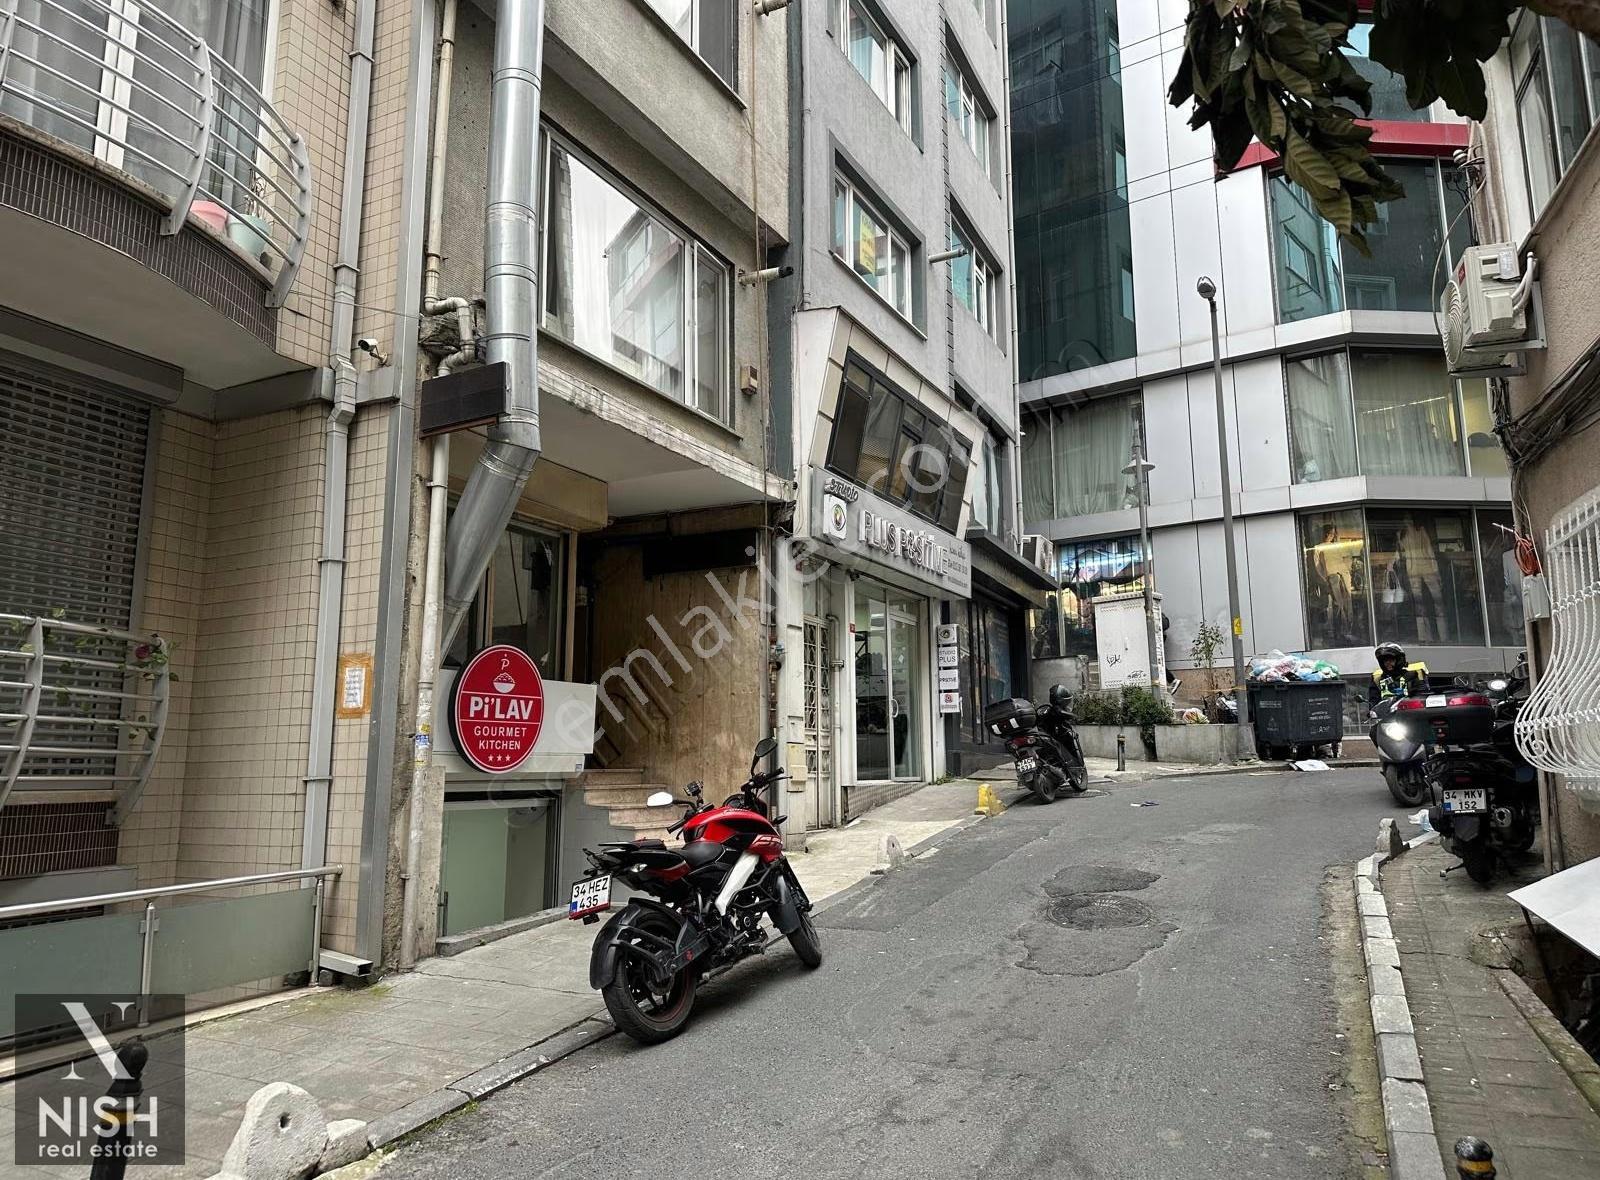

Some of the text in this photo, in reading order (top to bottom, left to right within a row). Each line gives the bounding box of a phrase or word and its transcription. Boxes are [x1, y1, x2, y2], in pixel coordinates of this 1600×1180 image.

[859, 510, 896, 552] PLUS
[473, 725, 527, 737] GOURMET
[478, 739, 521, 750] KITCHEN
[1445, 790, 1483, 800] 34 MKV
[1459, 801, 1477, 810] 152
[573, 877, 609, 898] 34 HEZ
[579, 894, 599, 909] 435
